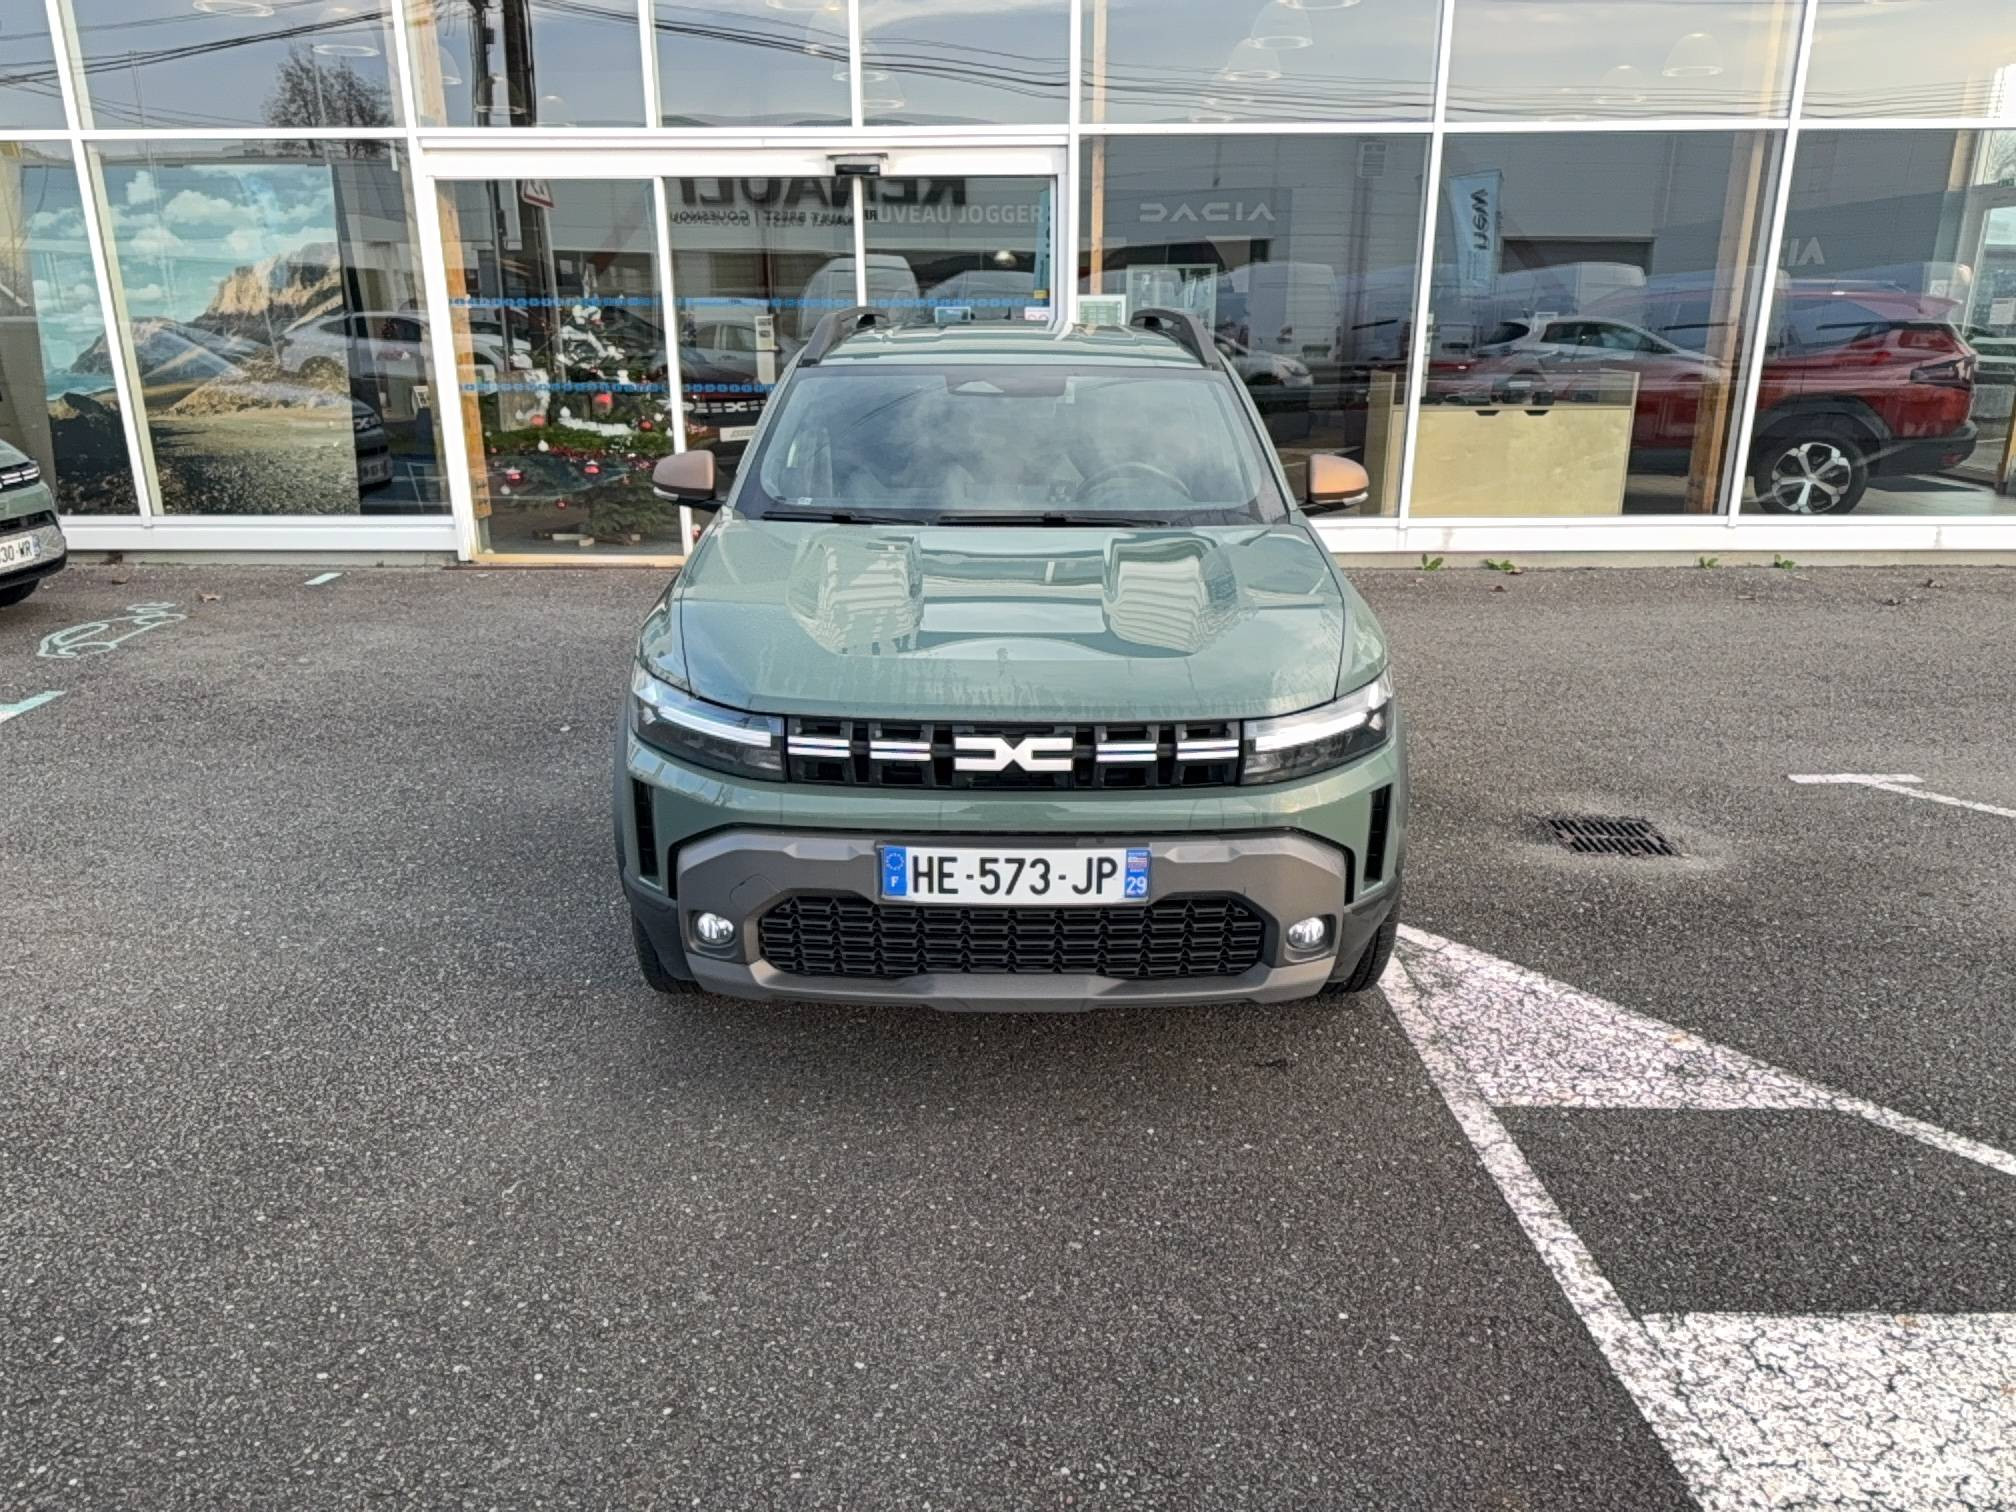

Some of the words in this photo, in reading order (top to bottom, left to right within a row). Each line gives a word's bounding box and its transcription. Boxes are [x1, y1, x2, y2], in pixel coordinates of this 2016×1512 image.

[957, 204, 1044, 224] JOGGER
[1139, 202, 1276, 222] DACIA
[891, 876, 899, 887] F
[912, 855, 1118, 895] HE-573-JP
[1127, 876, 1147, 894] 29
